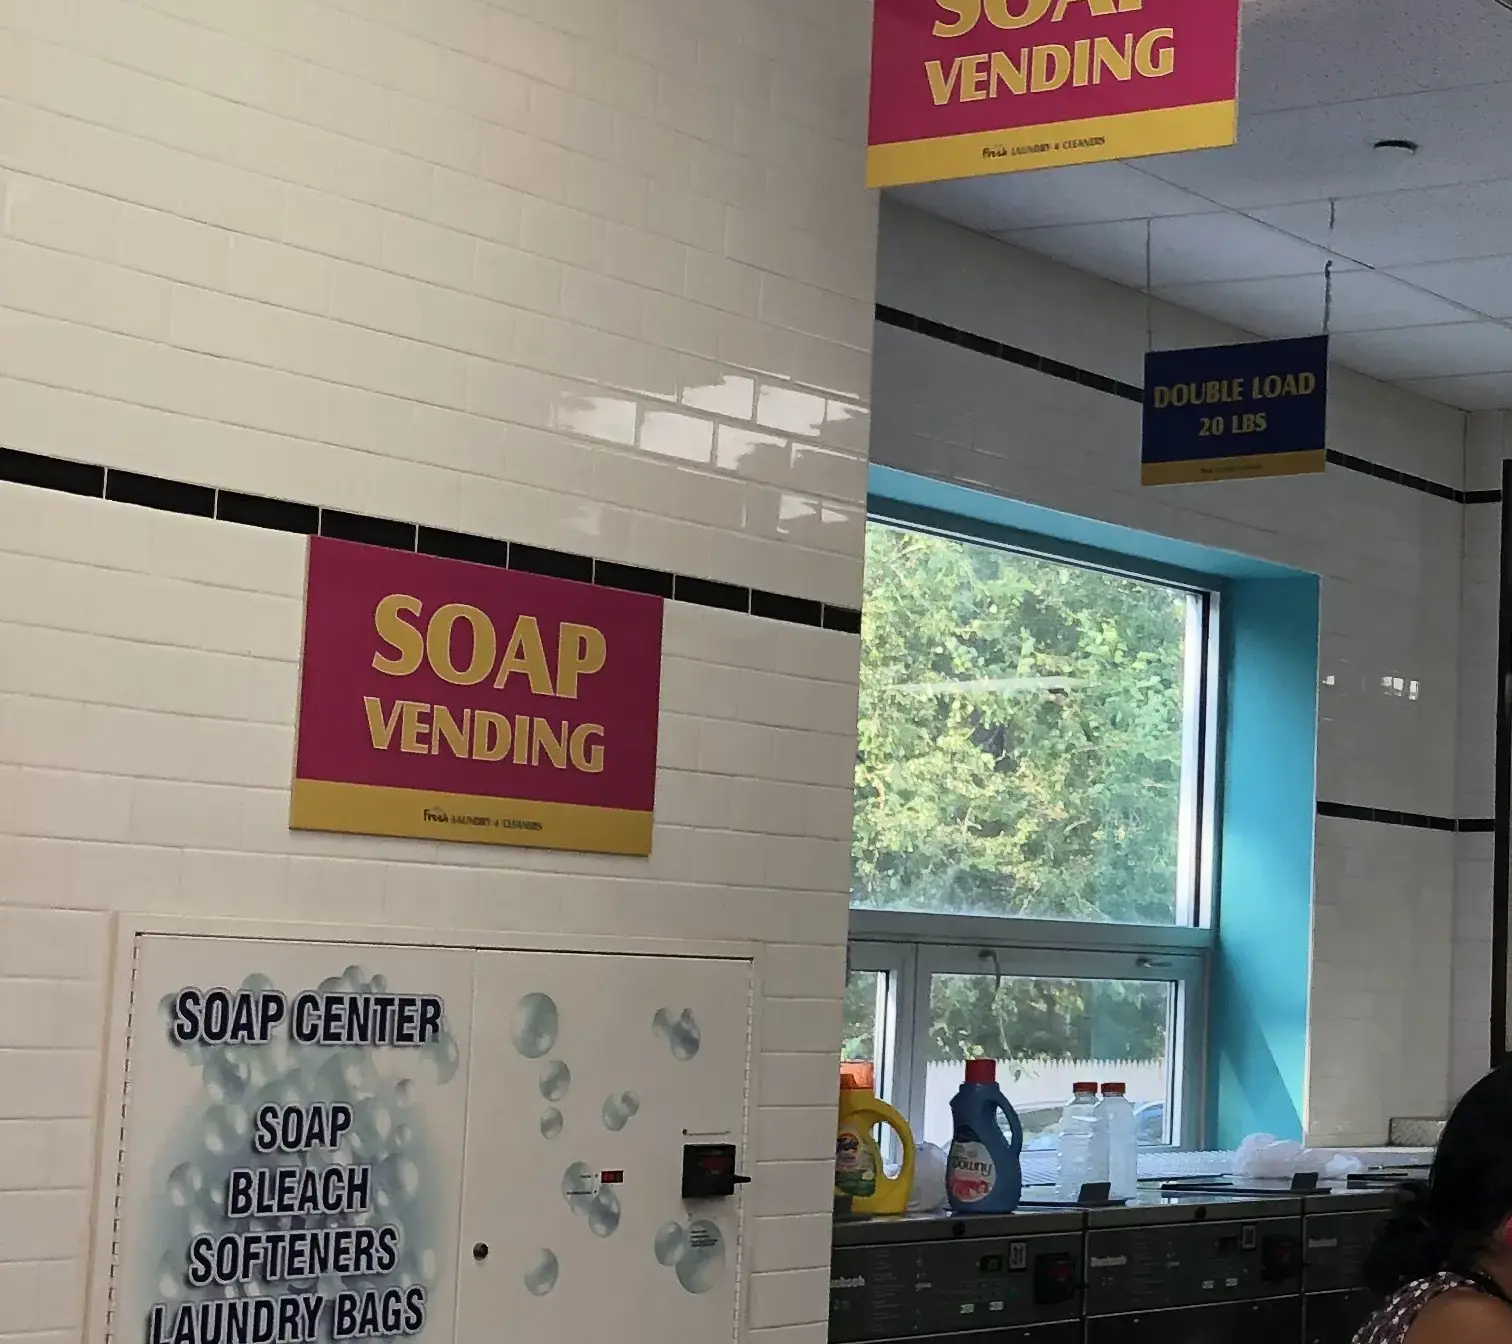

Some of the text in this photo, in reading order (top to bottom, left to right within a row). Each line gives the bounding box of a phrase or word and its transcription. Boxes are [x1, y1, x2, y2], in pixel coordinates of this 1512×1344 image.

[924, 28, 1175, 106] VENDING
[1153, 372, 1316, 408] DOUBLE LOAD
[1199, 412, 1267, 436] 20 LBS
[371, 593, 607, 699] SOAP
[363, 695, 605, 773] VENDING
[176, 989, 442, 1044] SOAP CENTER
[257, 1105, 352, 1151] SOAP
[230, 1167, 370, 1215] BLEACH
[952, 1156, 992, 1177] Downy
[191, 1228, 398, 1284] SOFTENERS
[335, 1287, 424, 1337] BAGS
